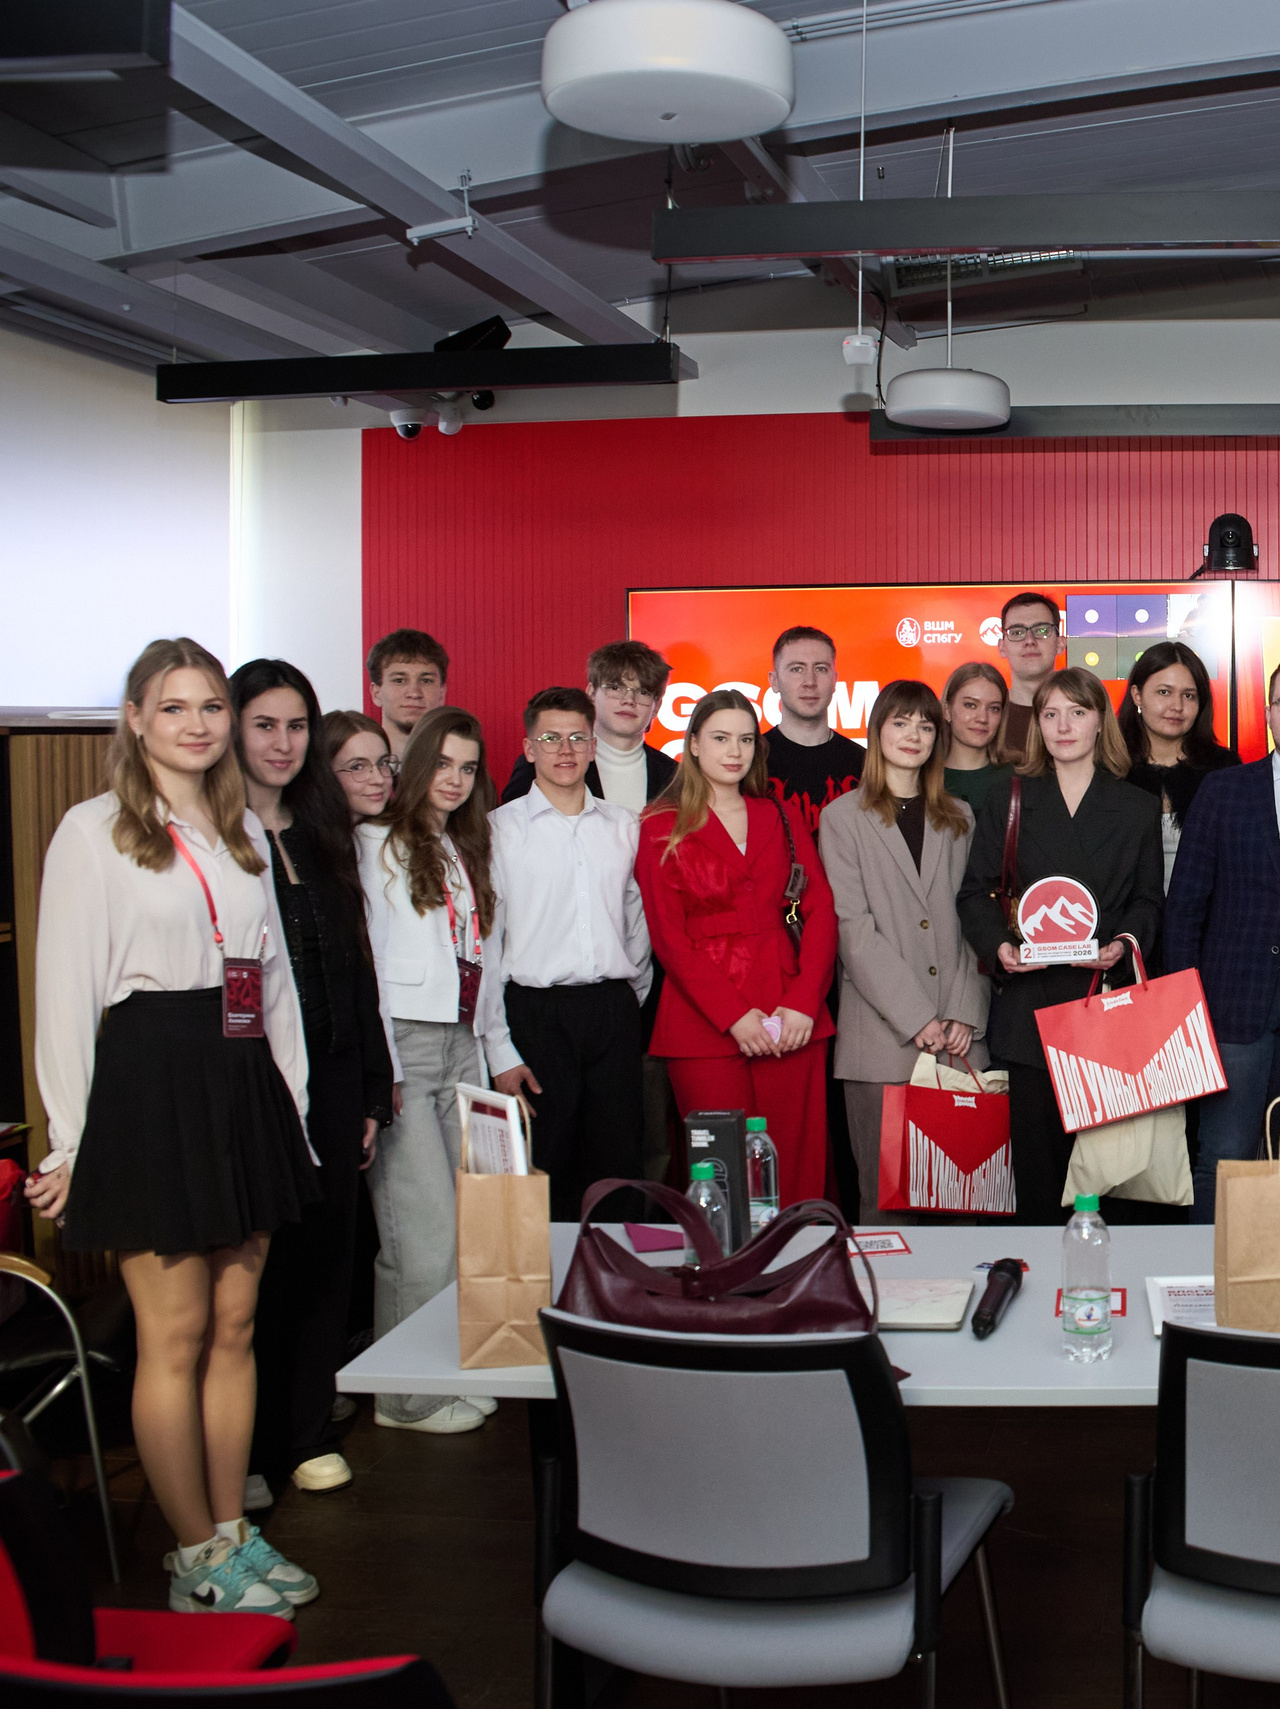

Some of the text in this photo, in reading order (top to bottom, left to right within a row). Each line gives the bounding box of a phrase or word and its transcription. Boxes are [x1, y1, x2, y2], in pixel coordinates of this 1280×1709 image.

[923, 620, 955, 631] ВШМ
[923, 632, 963, 644] СПбГУ
[1023, 947, 1032, 959] 2
[1047, 1000, 1226, 1131] ДЛЯ УМНЫХ И СВОБОДНЫХ
[908, 1119, 929, 1208] ДЛЯ
